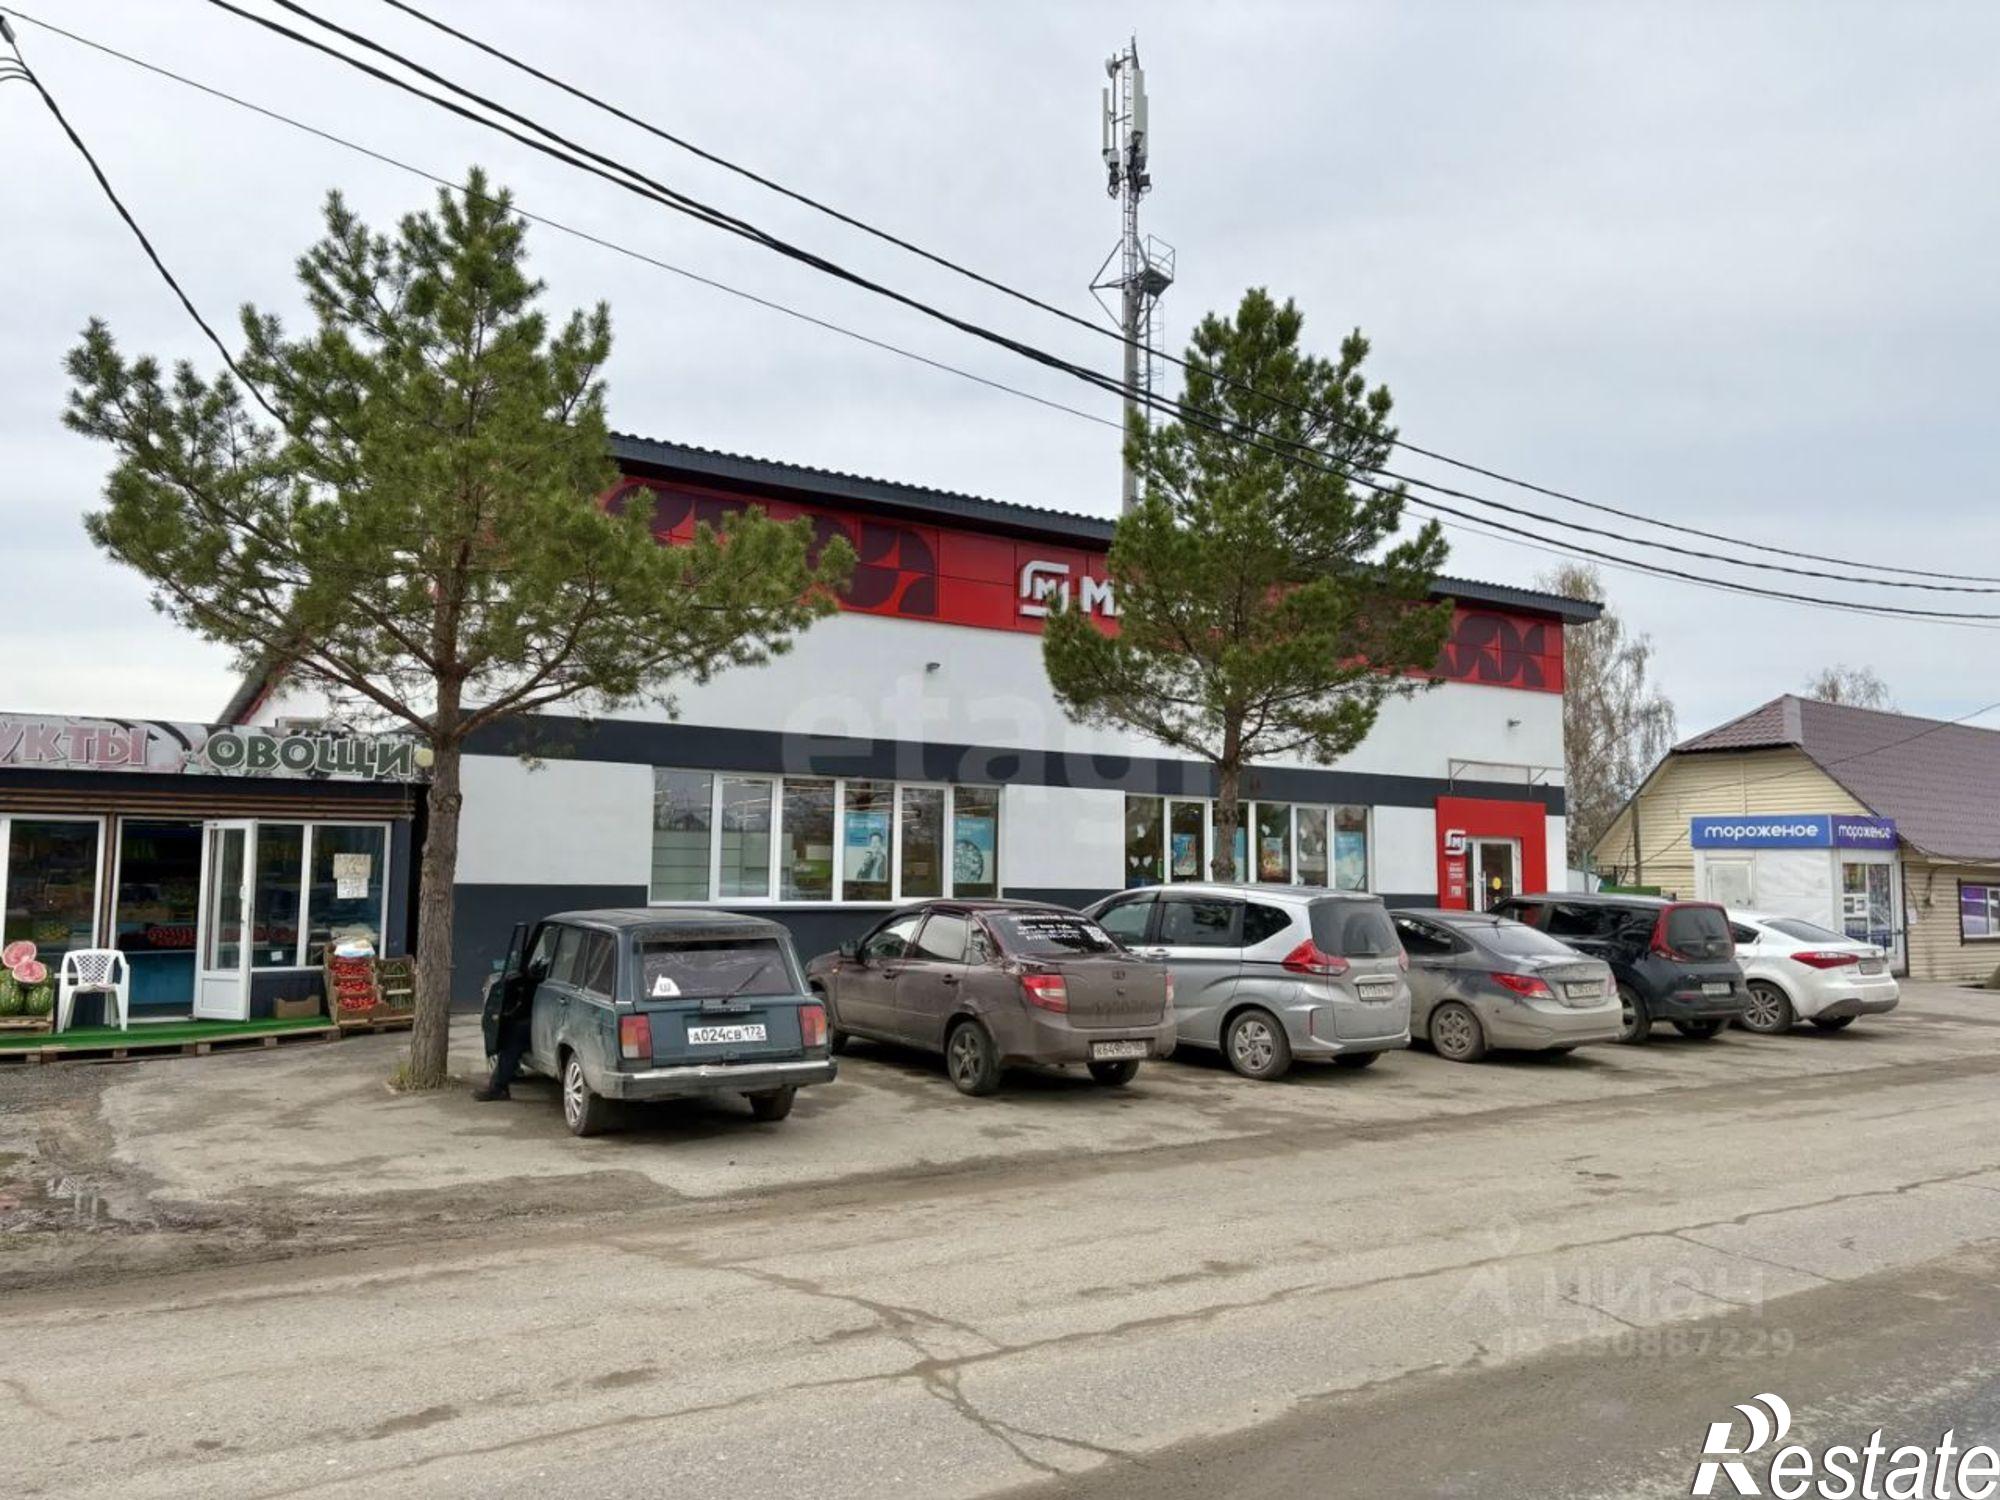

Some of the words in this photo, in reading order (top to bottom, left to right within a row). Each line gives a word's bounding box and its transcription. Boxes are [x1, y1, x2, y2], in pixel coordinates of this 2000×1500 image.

[207, 732, 413, 780] ОВОЩИ
[1705, 823, 1819, 840] мороженое
[1838, 825, 1891, 840] мороженое
